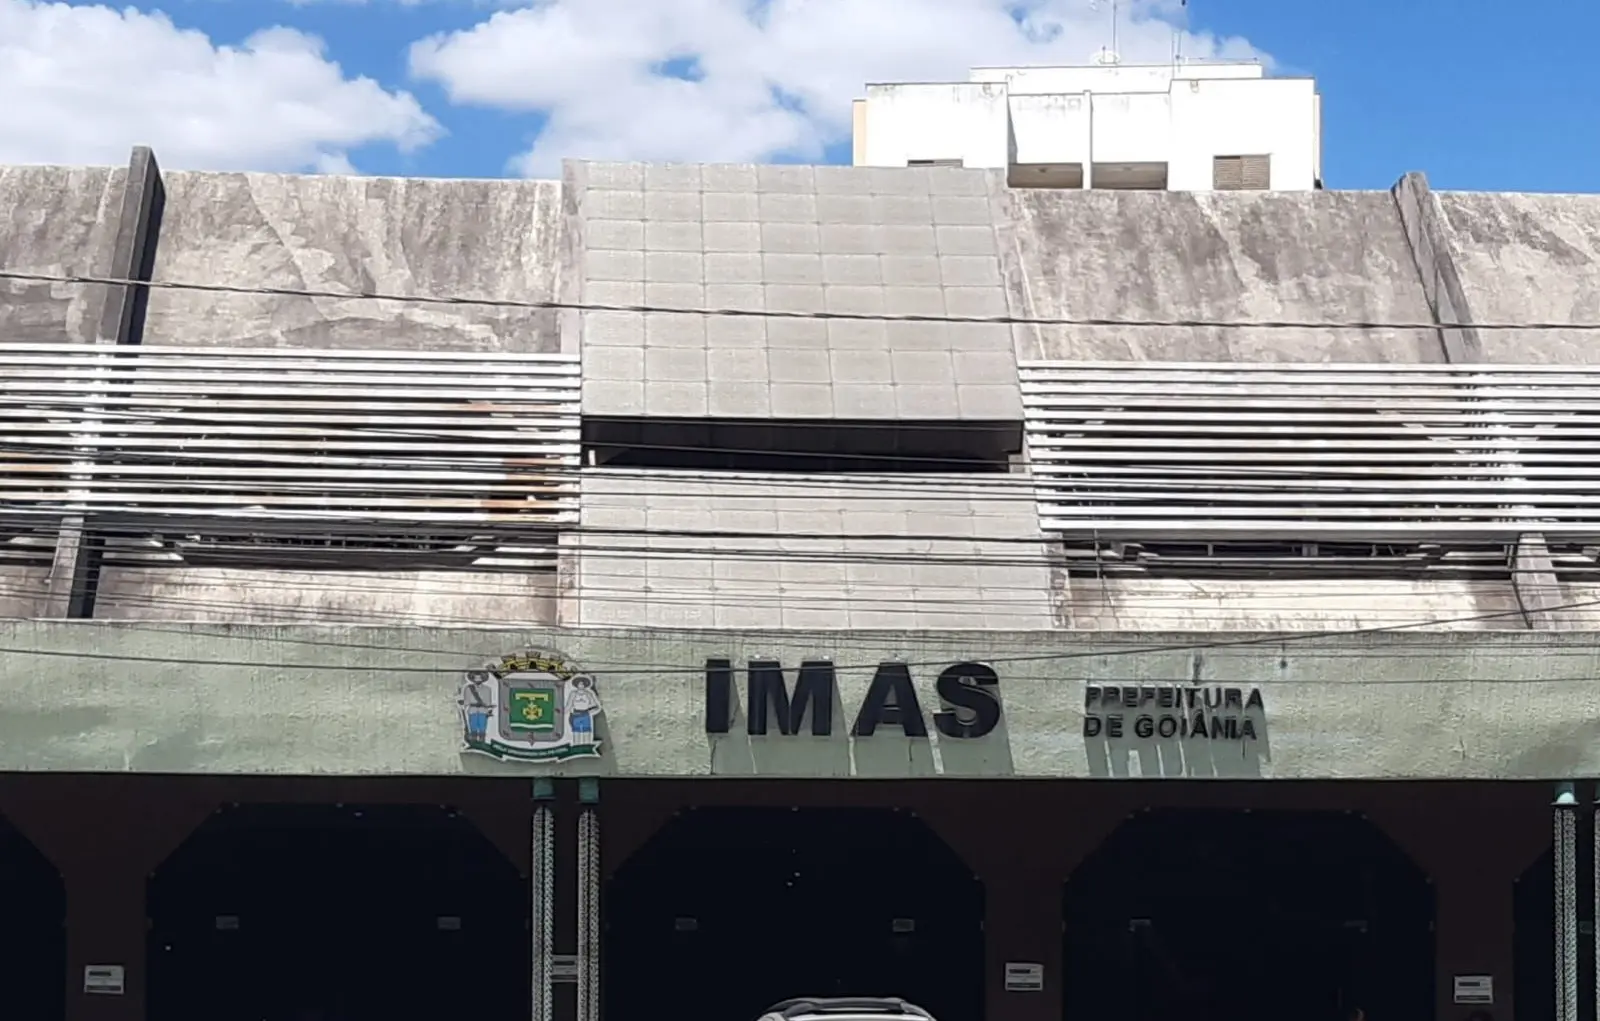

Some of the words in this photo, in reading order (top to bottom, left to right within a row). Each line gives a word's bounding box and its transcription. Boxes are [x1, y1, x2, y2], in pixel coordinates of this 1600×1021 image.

[705, 659, 1000, 738] IMAS
[1085, 686, 1264, 709] PREFEITURA
[1084, 716, 1124, 738] DE
